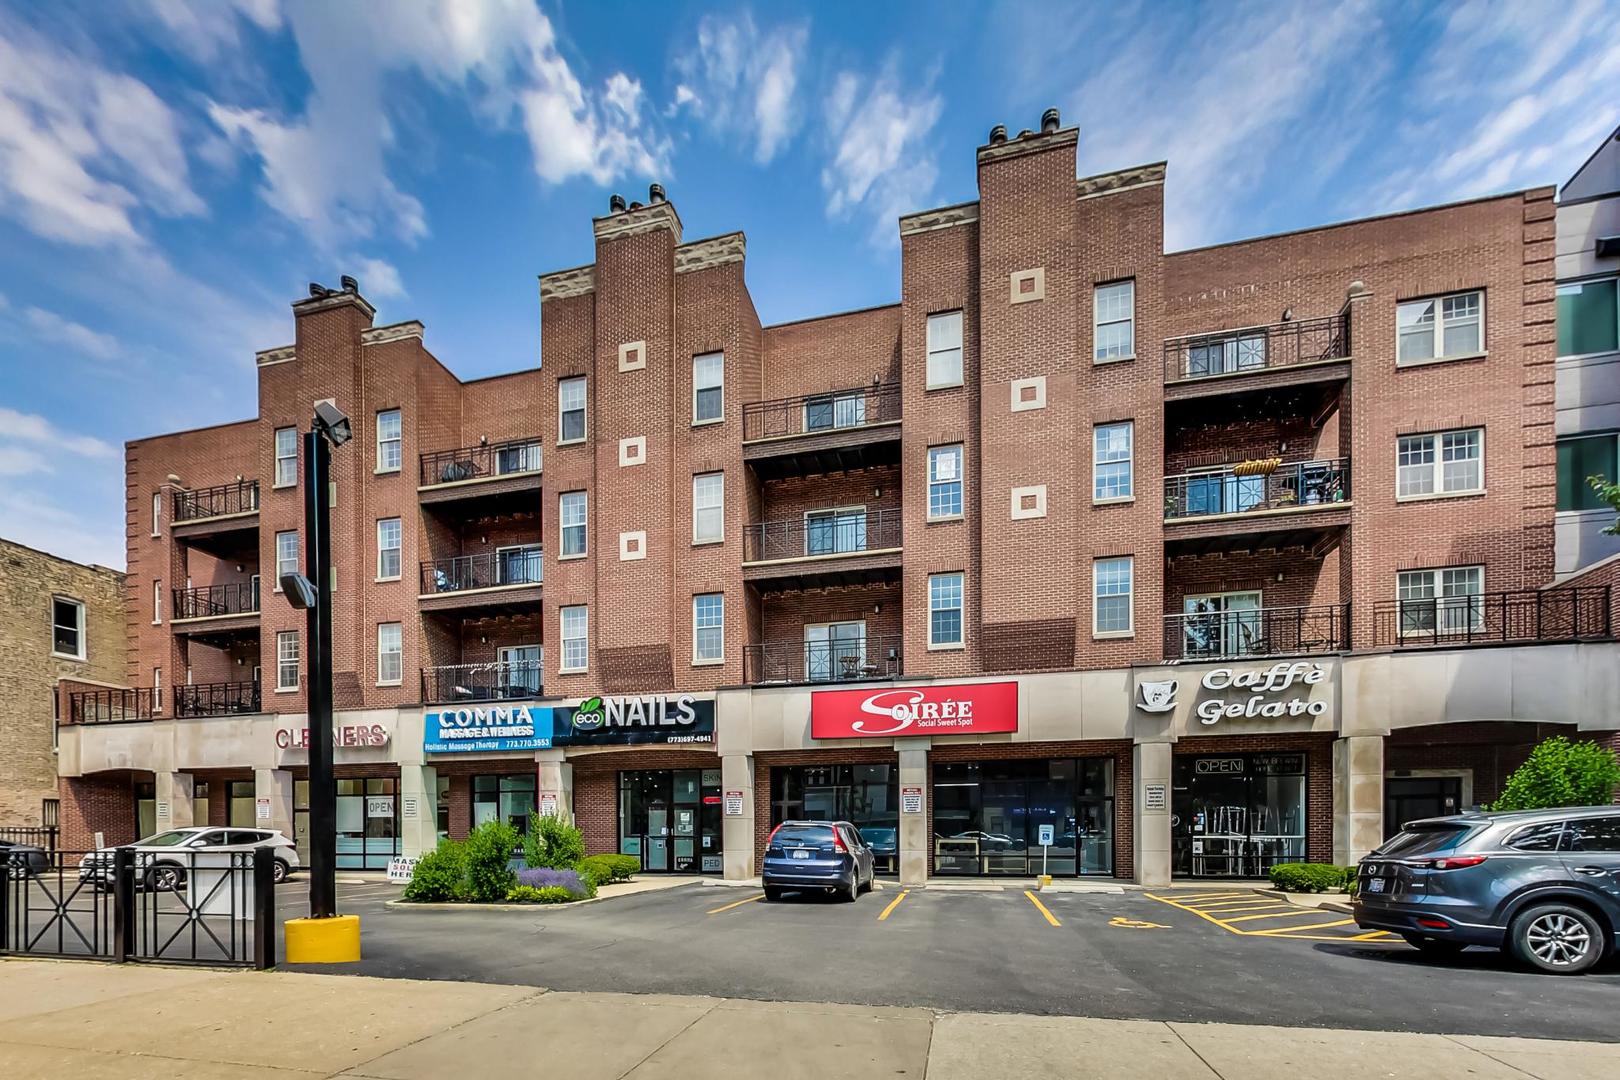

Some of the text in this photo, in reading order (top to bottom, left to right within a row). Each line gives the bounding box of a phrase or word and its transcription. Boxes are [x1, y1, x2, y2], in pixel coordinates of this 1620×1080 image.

[1202, 662, 1325, 692] Caffè
[438, 705, 534, 727] COMMA
[576, 695, 696, 726] eco NAILS
[1197, 696, 1327, 725] Gelato
[918, 717, 973, 727] Social Sweet Spot
[275, 725, 386, 750] CLENERS
[425, 739, 550, 751] Holistic Massage Therapy 773.770.3553
[1197, 760, 1241, 772] OPEN
[369, 802, 393, 813] OPEN
